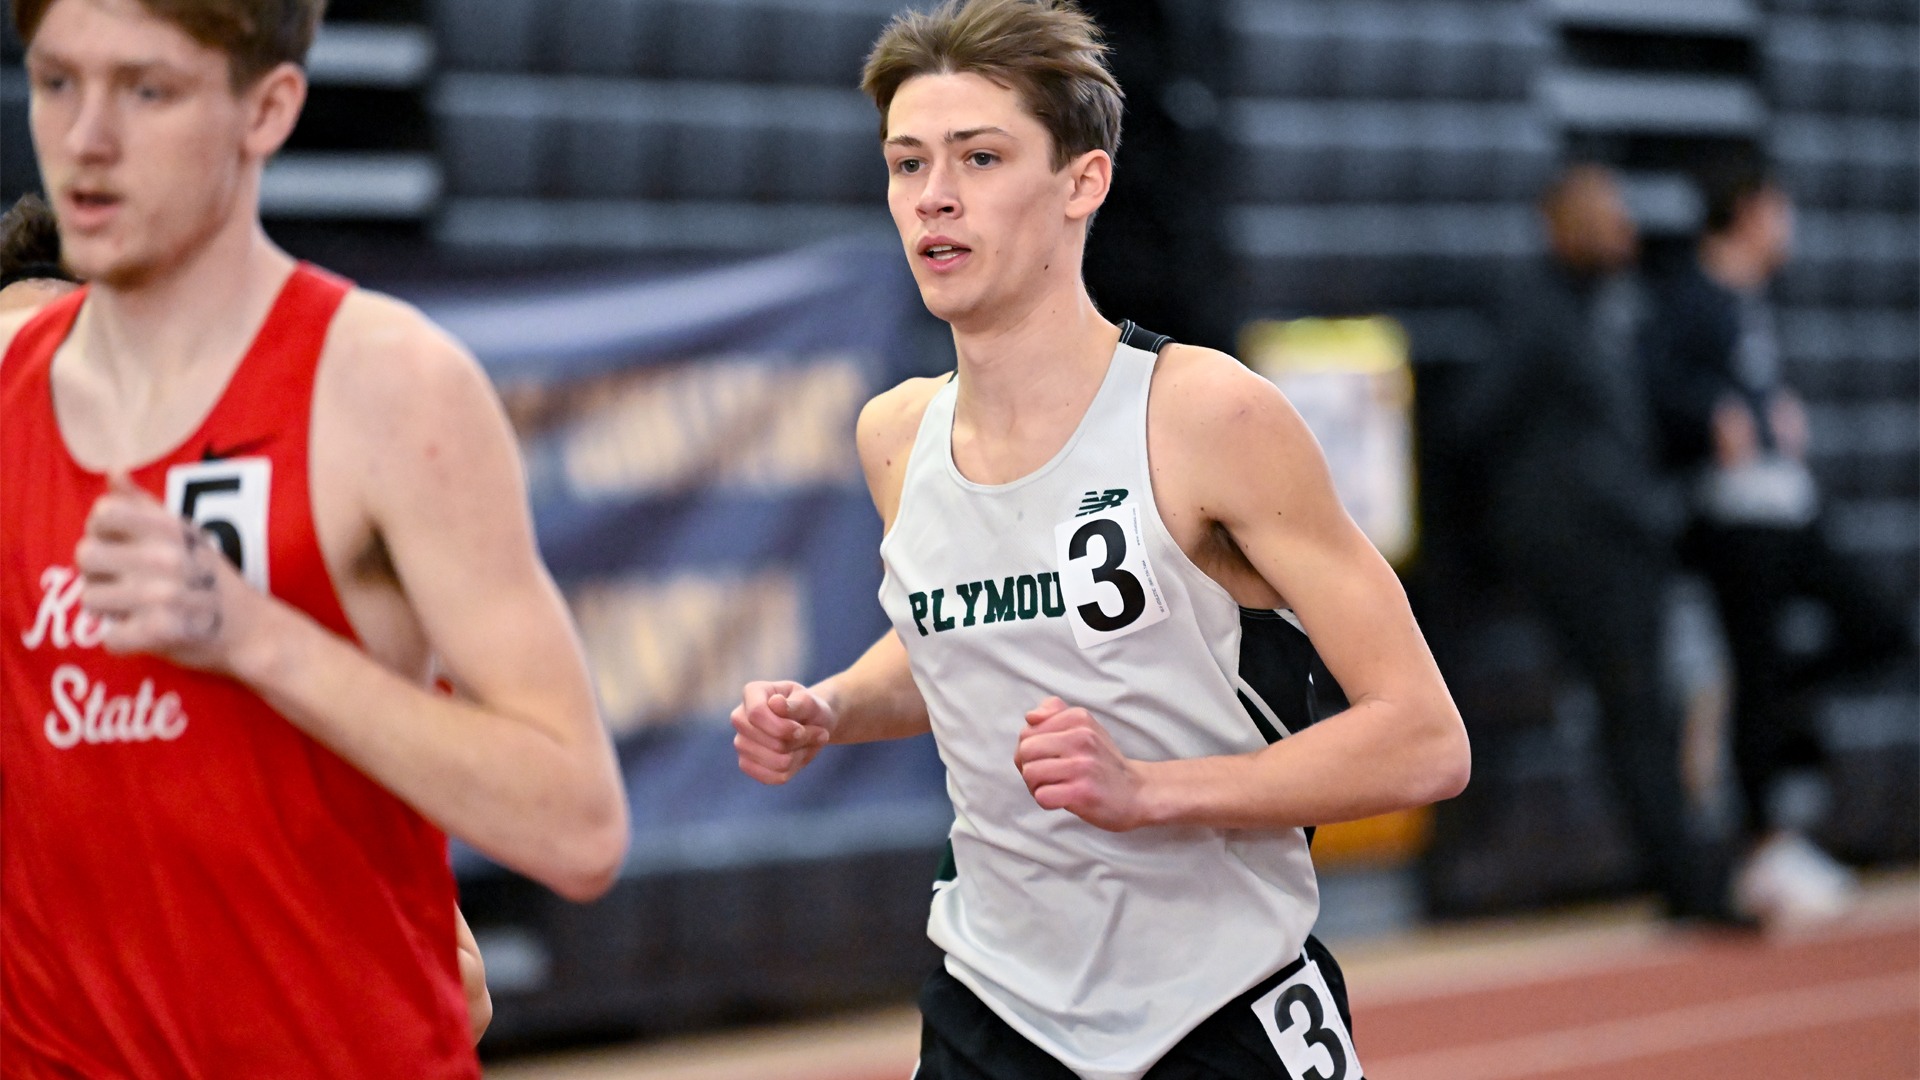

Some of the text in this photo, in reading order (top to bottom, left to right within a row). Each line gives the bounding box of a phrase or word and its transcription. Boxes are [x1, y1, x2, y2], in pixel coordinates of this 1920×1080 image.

[908, 571, 1066, 637] PLYMOU
[1069, 518, 1146, 632] 3
[43, 663, 189, 750] State
[1274, 983, 1347, 1080] 3
